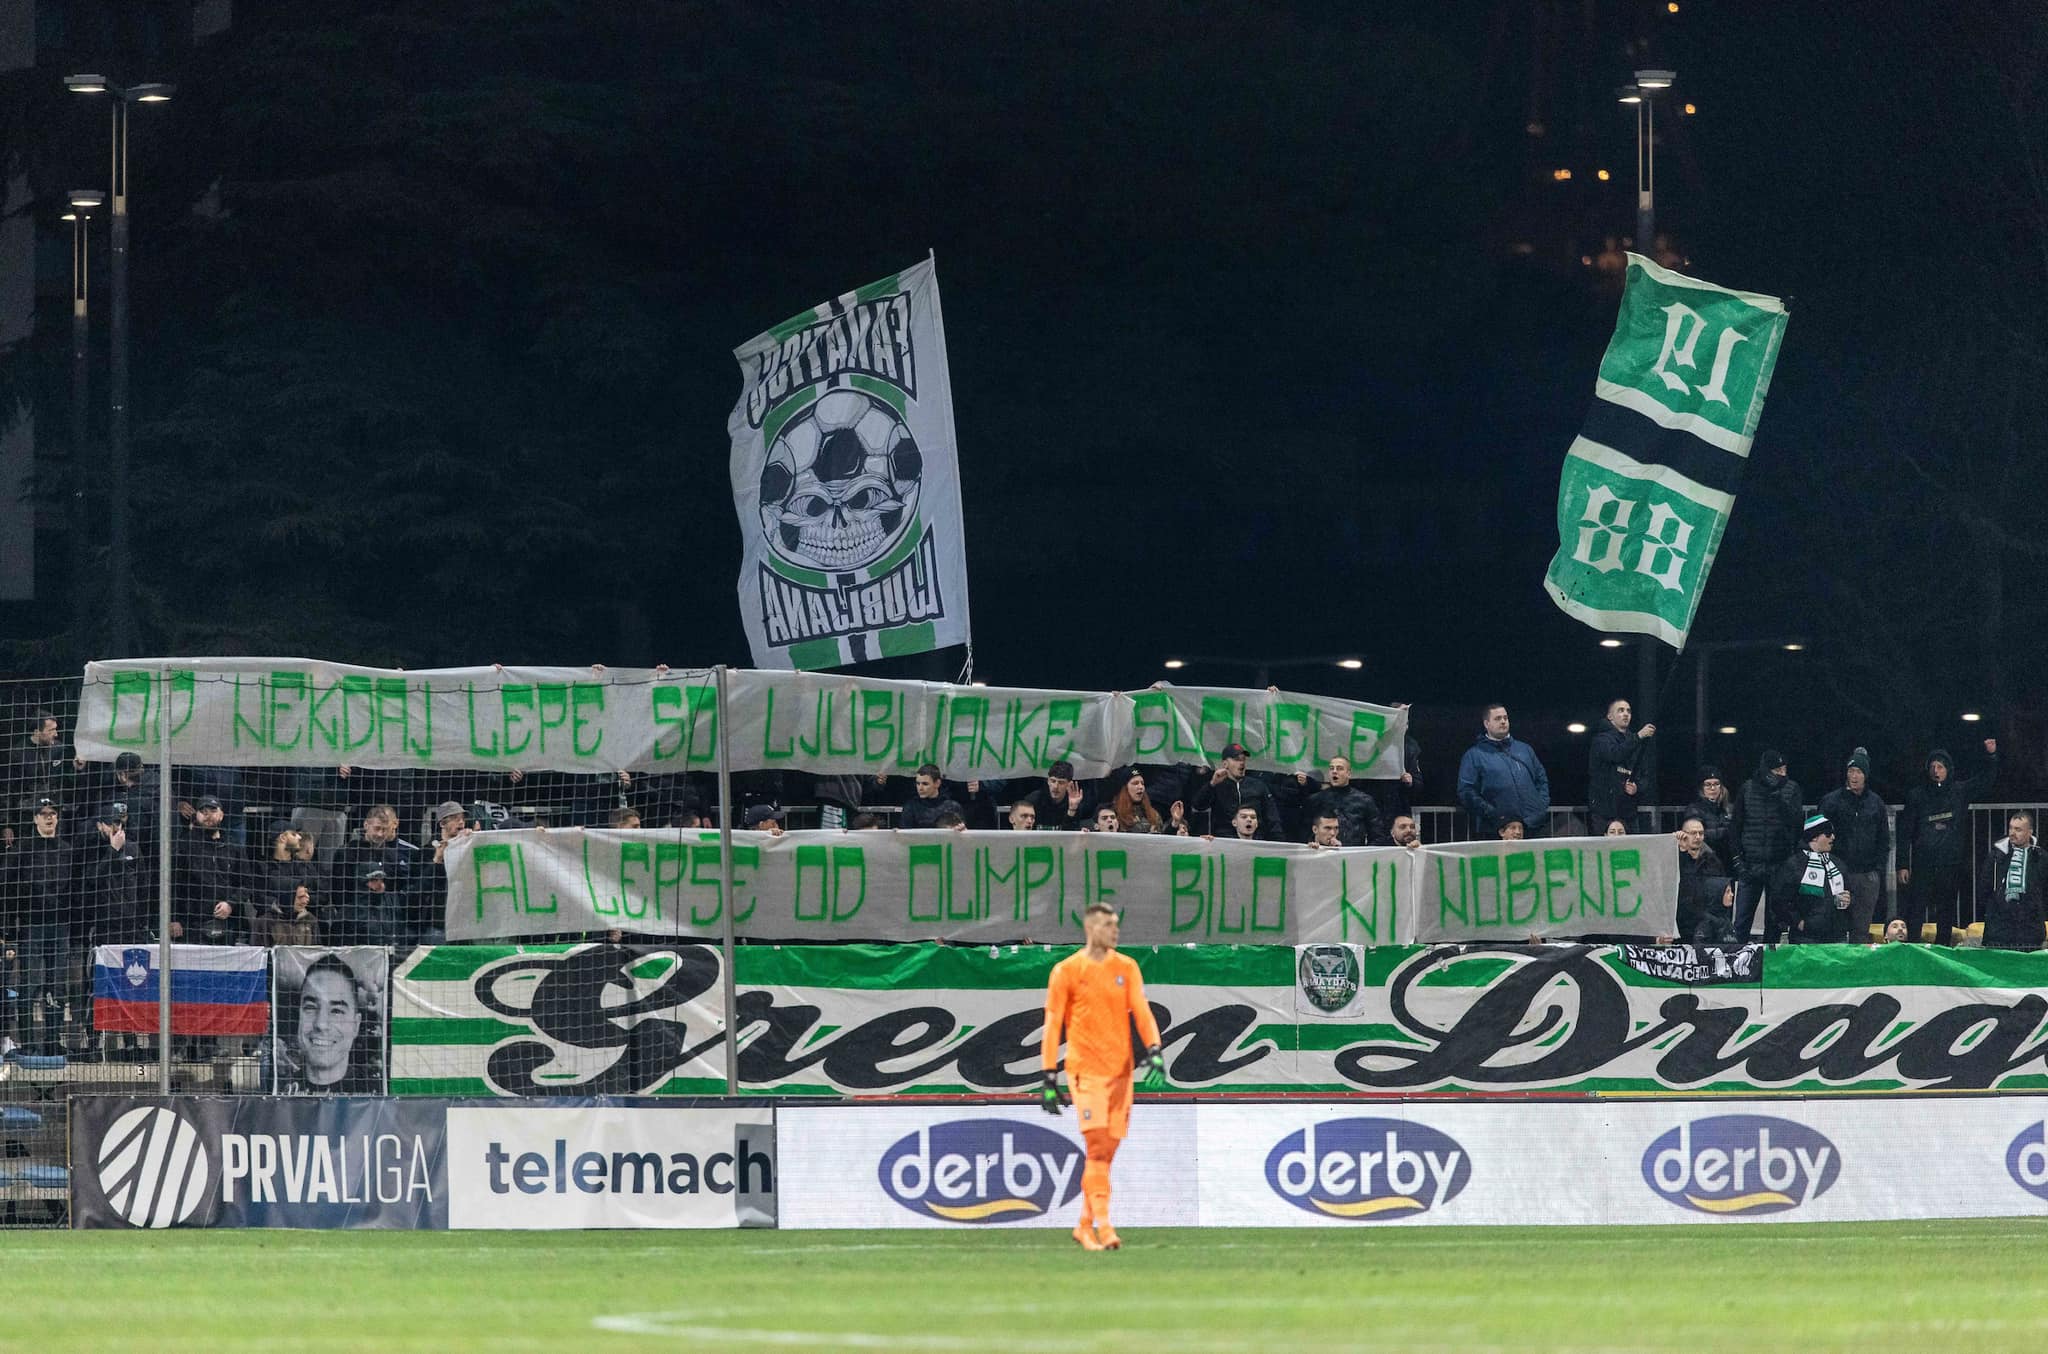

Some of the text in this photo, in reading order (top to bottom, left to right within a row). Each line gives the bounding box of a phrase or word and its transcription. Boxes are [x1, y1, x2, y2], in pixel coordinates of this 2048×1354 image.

[108, 670, 195, 746] OD
[235, 671, 433, 760] NEKDAJ
[468, 682, 605, 758] LEPE
[653, 686, 718, 763] SO
[764, 687, 1083, 770] LJUBLJANKE
[474, 843, 558, 923] AL
[795, 845, 867, 923] OD
[908, 844, 1128, 927] OLIMPIJE
[1171, 853, 1288, 936] BILO
[1341, 858, 1397, 943] NI
[1437, 848, 1642, 929] NOBENE
[476, 944, 2048, 1096] Green Drag
[138, 1064, 145, 1076] 3
[222, 1134, 433, 1204] PRVALIGA
[485, 1138, 772, 1195] telemach
[891, 1125, 1079, 1209] derby
[1277, 1125, 1464, 1207] derby
[1653, 1121, 1831, 1201] derby
